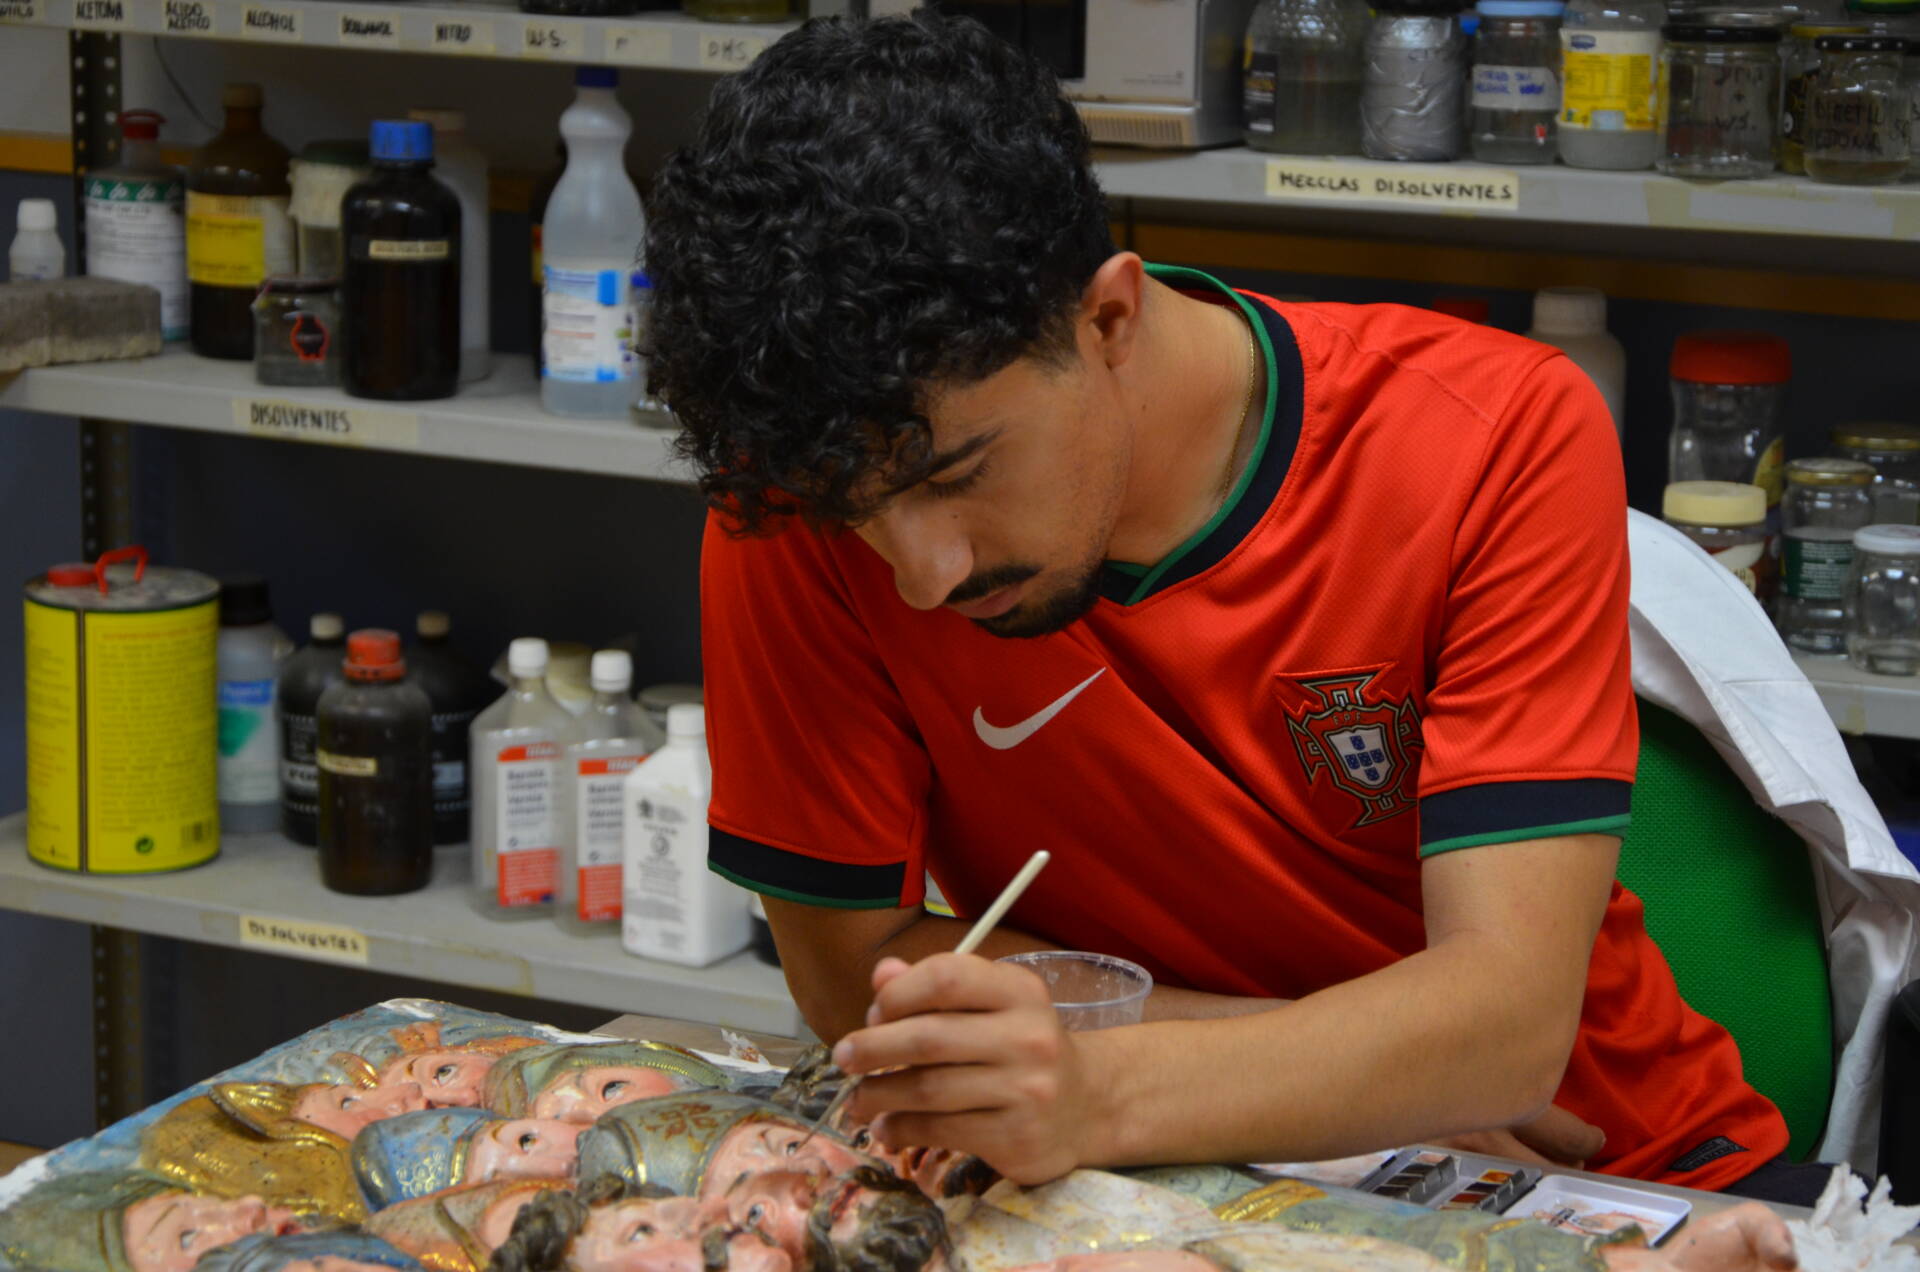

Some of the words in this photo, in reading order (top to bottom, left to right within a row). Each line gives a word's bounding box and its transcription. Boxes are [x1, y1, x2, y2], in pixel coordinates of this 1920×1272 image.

[75, 2, 123, 20] ACETONA
[246, 10, 295, 32] ALCOHOL
[436, 24, 471, 42] NITRO
[1280, 170, 1359, 191] MEZCLAS
[1375, 178, 1512, 200] DISOLVENTES
[250, 403, 351, 432] DISOLVENTES
[249, 920, 359, 951] DISOLVENTES
